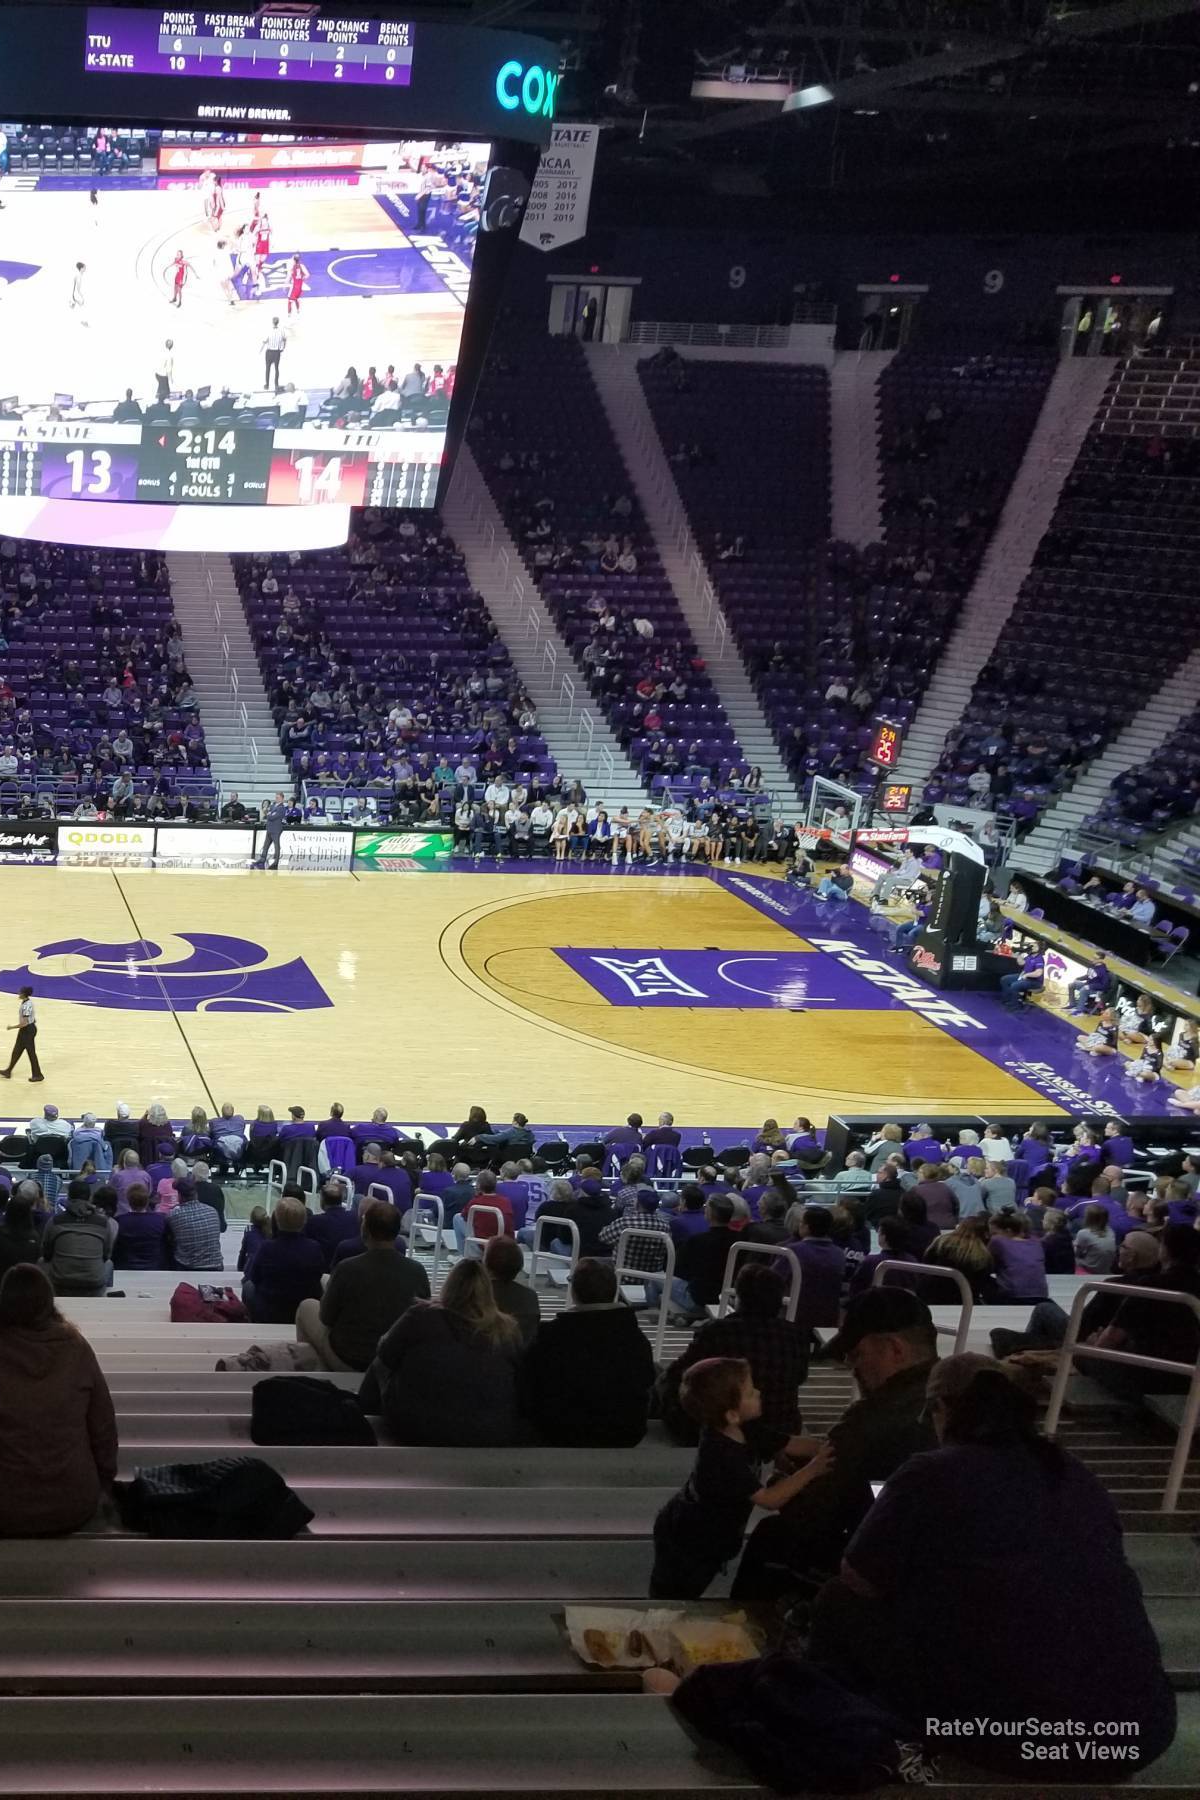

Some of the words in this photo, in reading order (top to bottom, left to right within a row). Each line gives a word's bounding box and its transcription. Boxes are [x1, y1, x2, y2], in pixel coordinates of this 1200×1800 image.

[163, 12, 195, 25] POINTS
[204, 14, 226, 26] FAST
[227, 15, 255, 28] BREAK
[262, 17, 293, 30] POINTS
[295, 19, 310, 30] OFF
[159, 24, 168, 34] IN
[170, 24, 197, 36] PAINT
[214, 26, 245, 38] POINTS
[316, 20, 335, 32] 2ND
[336, 21, 369, 34] CHANCE
[380, 22, 408, 35] BENCH
[259, 28, 310, 42] TURNOVERS
[326, 31, 358, 44] POINTS
[377, 34, 409, 46] POINTS
[88, 35, 111, 48] TTU
[173, 39, 183, 52] 6
[223, 40, 232, 54] 0
[279, 43, 289, 57] 0
[336, 46, 345, 60] 2
[387, 48, 396, 61] 0
[87, 54, 134, 68] K-STATE
[169, 56, 185, 70] 10
[222, 58, 231, 72] 2
[279, 62, 288, 75] 2
[334, 64, 343, 78] 2
[385, 66, 394, 80] 0
[496, 61, 557, 118] COX
[198, 106, 246, 119] BRITTANY
[552, 129, 592, 142] TATE
[539, 158, 571, 168] NCAA
[557, 181, 578, 190] 2012
[556, 192, 577, 200] 2016
[554, 203, 576, 211] 2017
[553, 214, 575, 222] 2019
[729, 266, 746, 289] 9
[984, 270, 1004, 293] 9
[176, 429, 236, 454] 2:14
[65, 450, 112, 494] 13
[169, 472, 177, 483] 4
[190, 472, 214, 484] TOL
[227, 472, 235, 485] 3
[138, 479, 161, 487] BONUS
[295, 456, 342, 504] 14
[169, 485, 175, 496] 1
[181, 485, 221, 498] FOULS
[227, 486, 233, 498] 1
[22, 832, 50, 846] Hut
[68, 832, 143, 846] QDOBA
[291, 833, 345, 842] Ascension
[807, 937, 987, 1029] K-STATE
[1022, 1062, 1092, 1099] KANSAS
[1004, 1060, 1094, 1115] UNIVERSI
